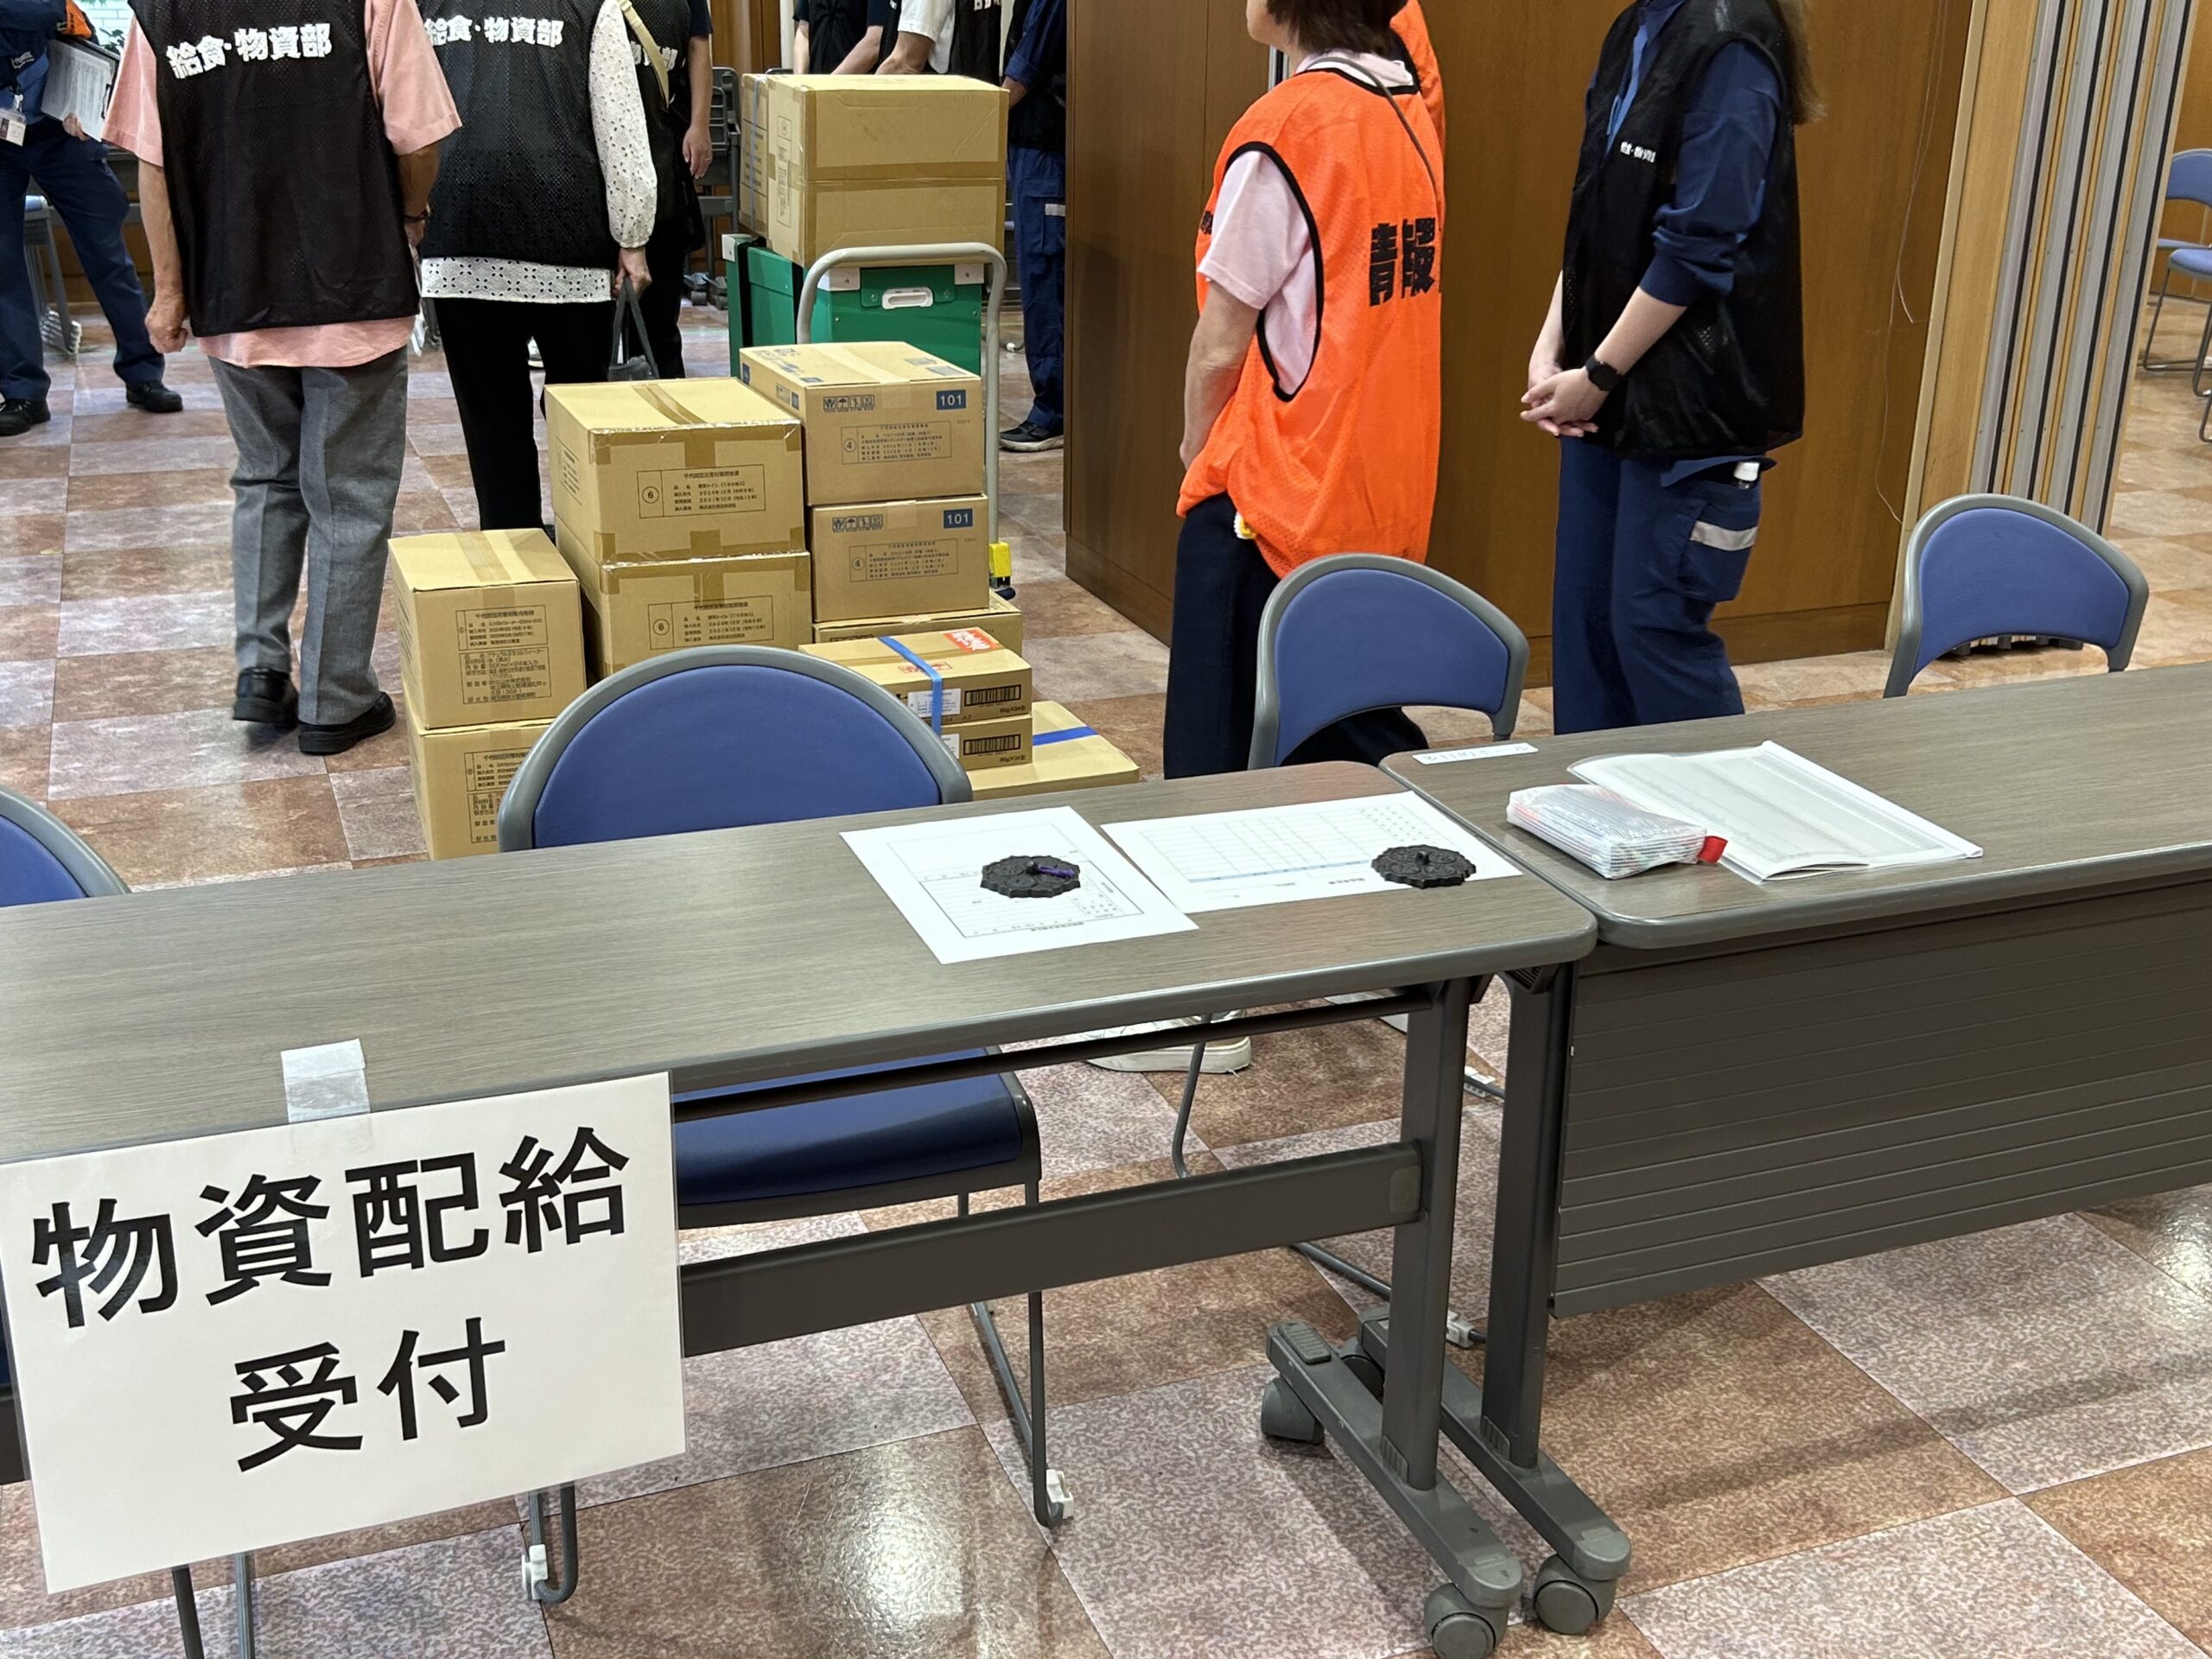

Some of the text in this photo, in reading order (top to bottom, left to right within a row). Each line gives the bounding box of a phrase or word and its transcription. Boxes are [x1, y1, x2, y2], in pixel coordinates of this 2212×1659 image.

[166, 23, 333, 79] 給食・物資部
[423, 15, 564, 48] 給食・物資部
[939, 394, 963, 407] 101
[946, 512, 969, 524] 101
[31, 1127, 630, 1328] 物資配給
[229, 1317, 507, 1472] 受付
